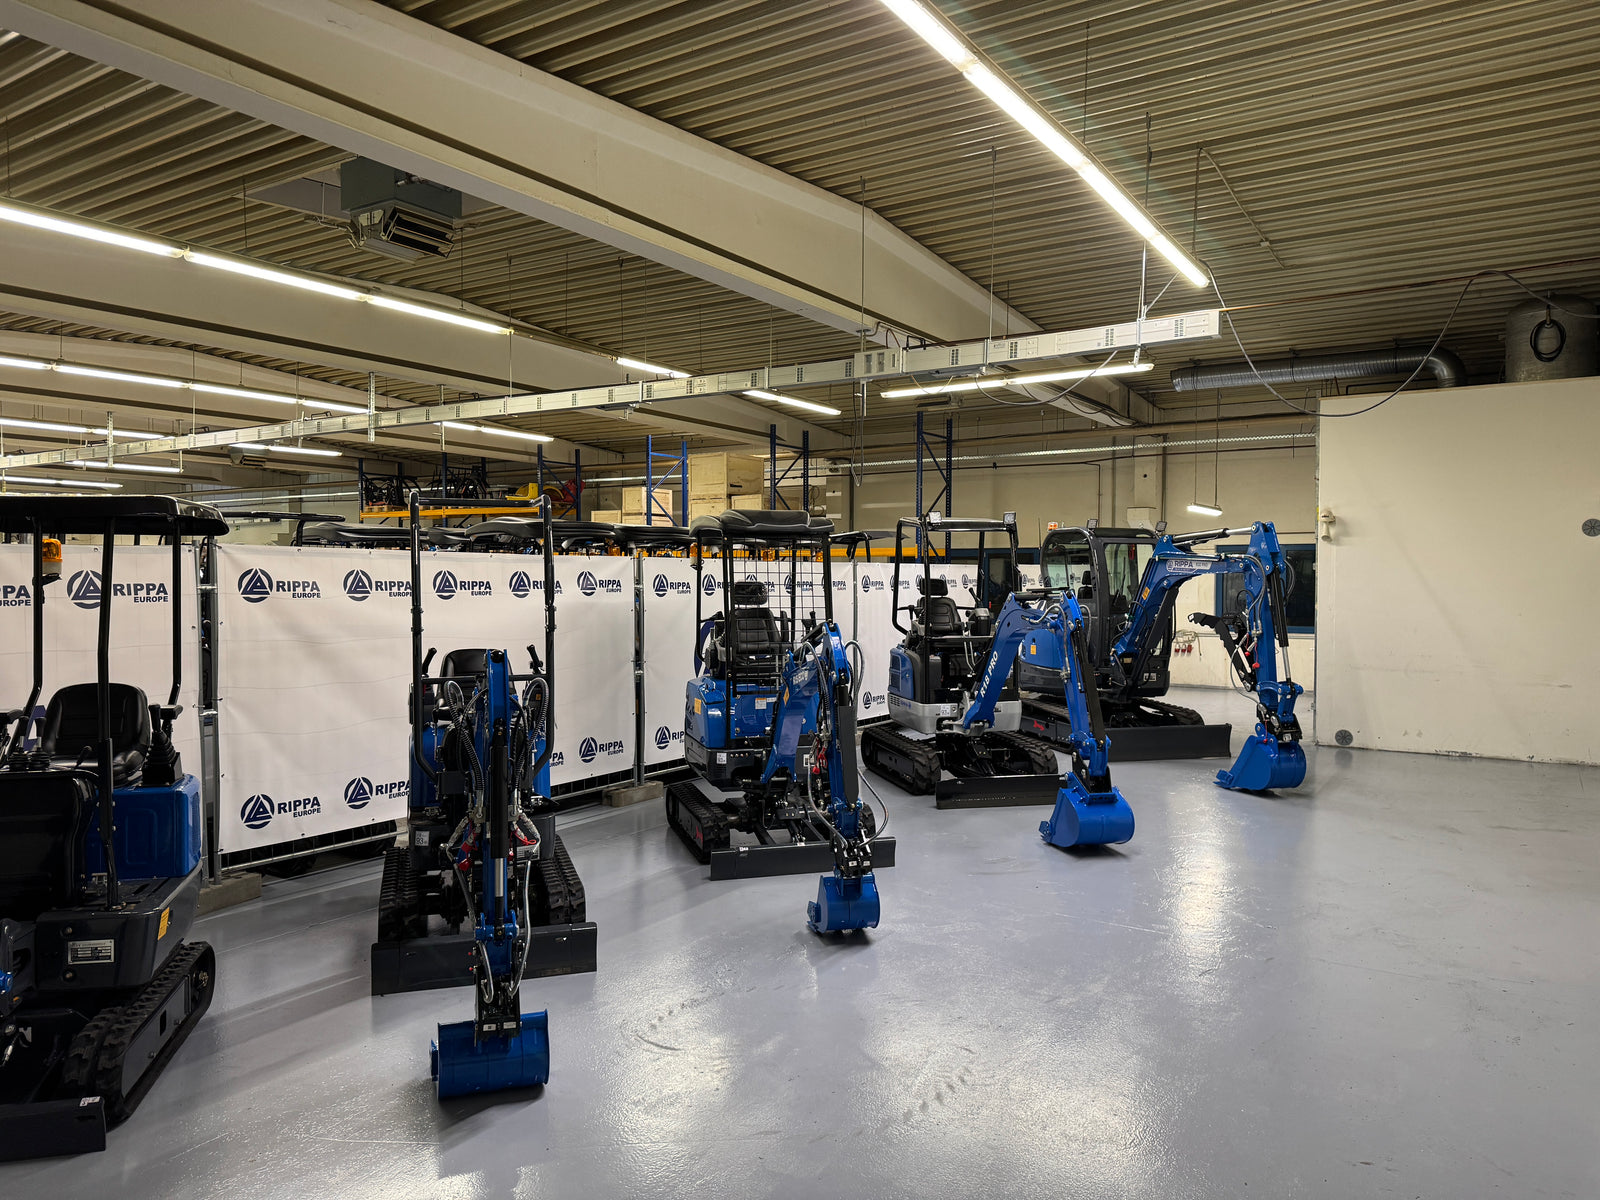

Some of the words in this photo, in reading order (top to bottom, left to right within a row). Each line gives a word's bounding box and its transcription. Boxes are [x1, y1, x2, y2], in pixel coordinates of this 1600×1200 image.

[113, 583, 168, 596] RIPPA
[275, 580, 321, 592] RIPPA
[374, 581, 412, 592] RIPPA
[459, 580, 492, 591] RIPPA
[598, 579, 622, 589] RIPPA
[669, 581, 691, 590] RIPPA
[0, 585, 31, 599] PA
[133, 595, 169, 603] EUROPE
[980, 674, 990, 698] R18
[987, 650, 998, 677] PRO
[598, 740, 624, 753] RIPPA
[607, 748, 624, 756] EUROPE
[277, 796, 321, 815] RIPPA
[293, 807, 321, 818] EUROPE
